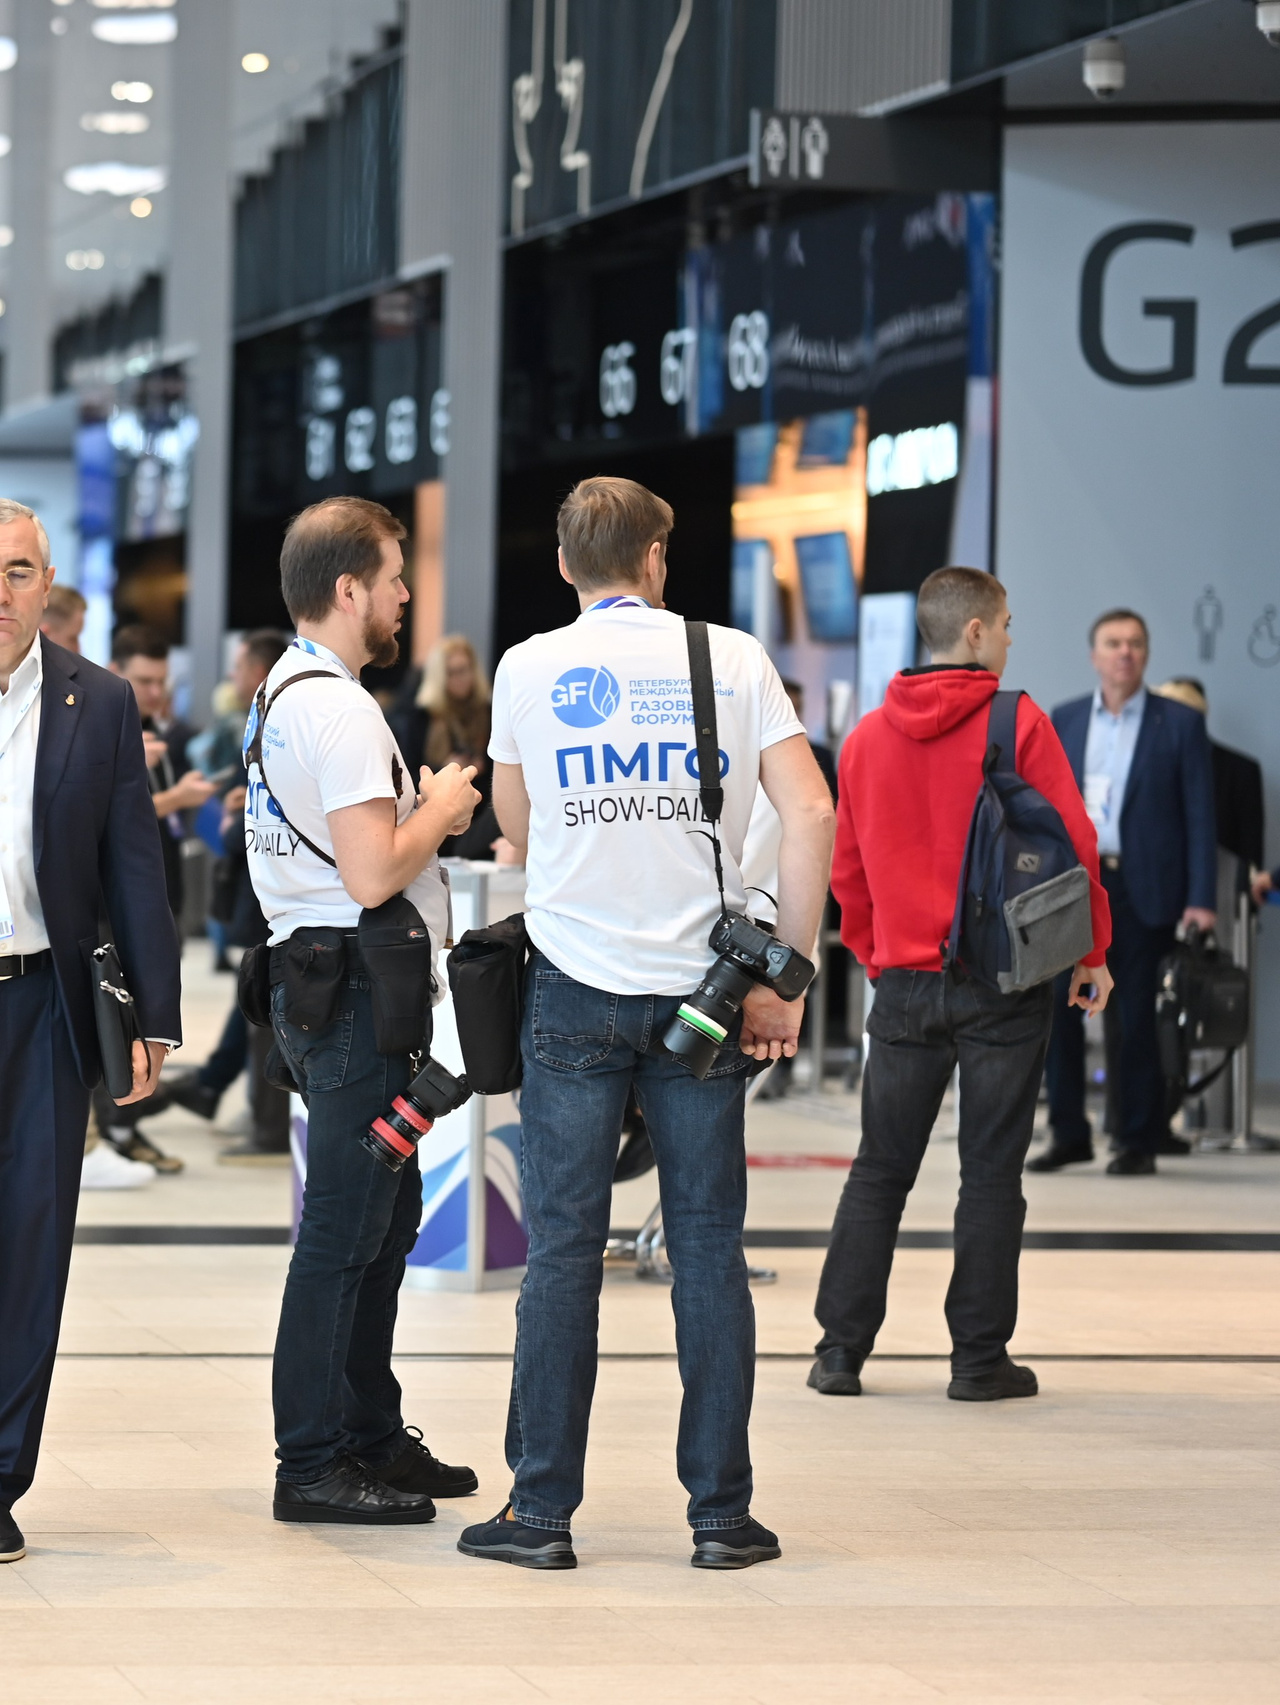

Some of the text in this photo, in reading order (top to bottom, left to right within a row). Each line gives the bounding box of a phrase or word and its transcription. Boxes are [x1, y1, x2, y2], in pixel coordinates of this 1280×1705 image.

[728, 310, 768, 391] 68
[629, 677, 722, 688] ПЕТЕРБУРГЙ
[551, 681, 588, 708] GF
[629, 687, 734, 697] МЕЖДУНАНЫЙ
[631, 700, 694, 712] ГАЗОВ
[631, 713, 696, 725] ФОРУМ
[564, 795, 721, 827] SHOW-DAIL
